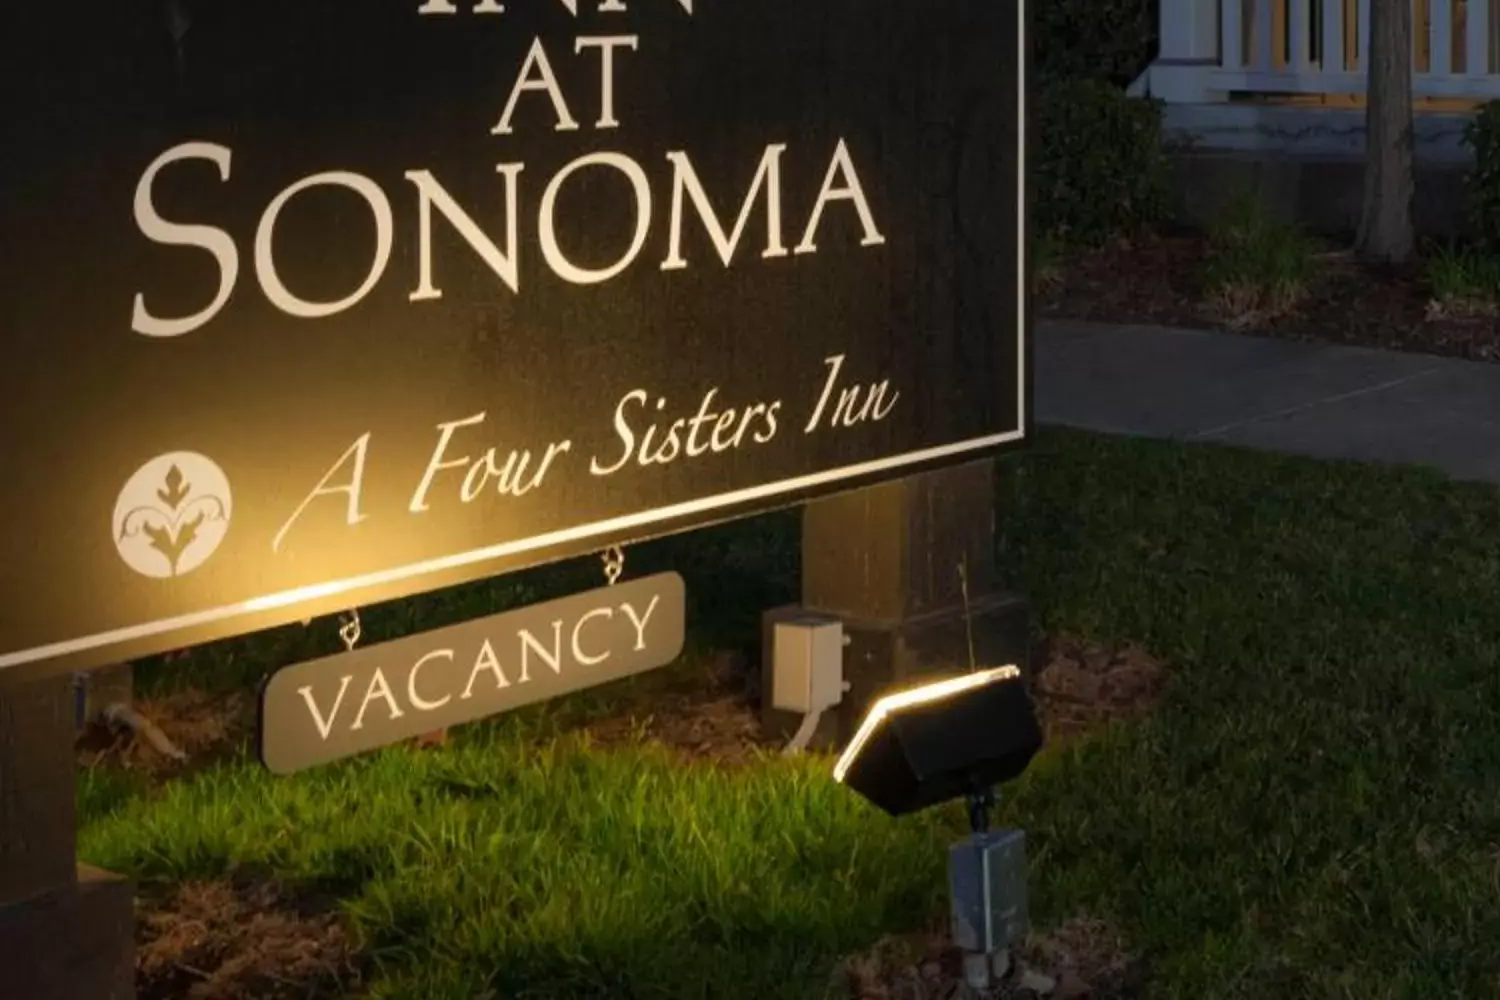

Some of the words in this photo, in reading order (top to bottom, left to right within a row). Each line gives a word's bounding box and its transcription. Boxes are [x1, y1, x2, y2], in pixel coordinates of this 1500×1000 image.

[490, 35, 638, 135] AT
[130, 137, 885, 338] SONOMA
[272, 431, 371, 552] A
[409, 411, 571, 513] Four
[589, 388, 781, 477] Sisters
[805, 354, 900, 434] Inn
[298, 595, 660, 741] VACANCY
